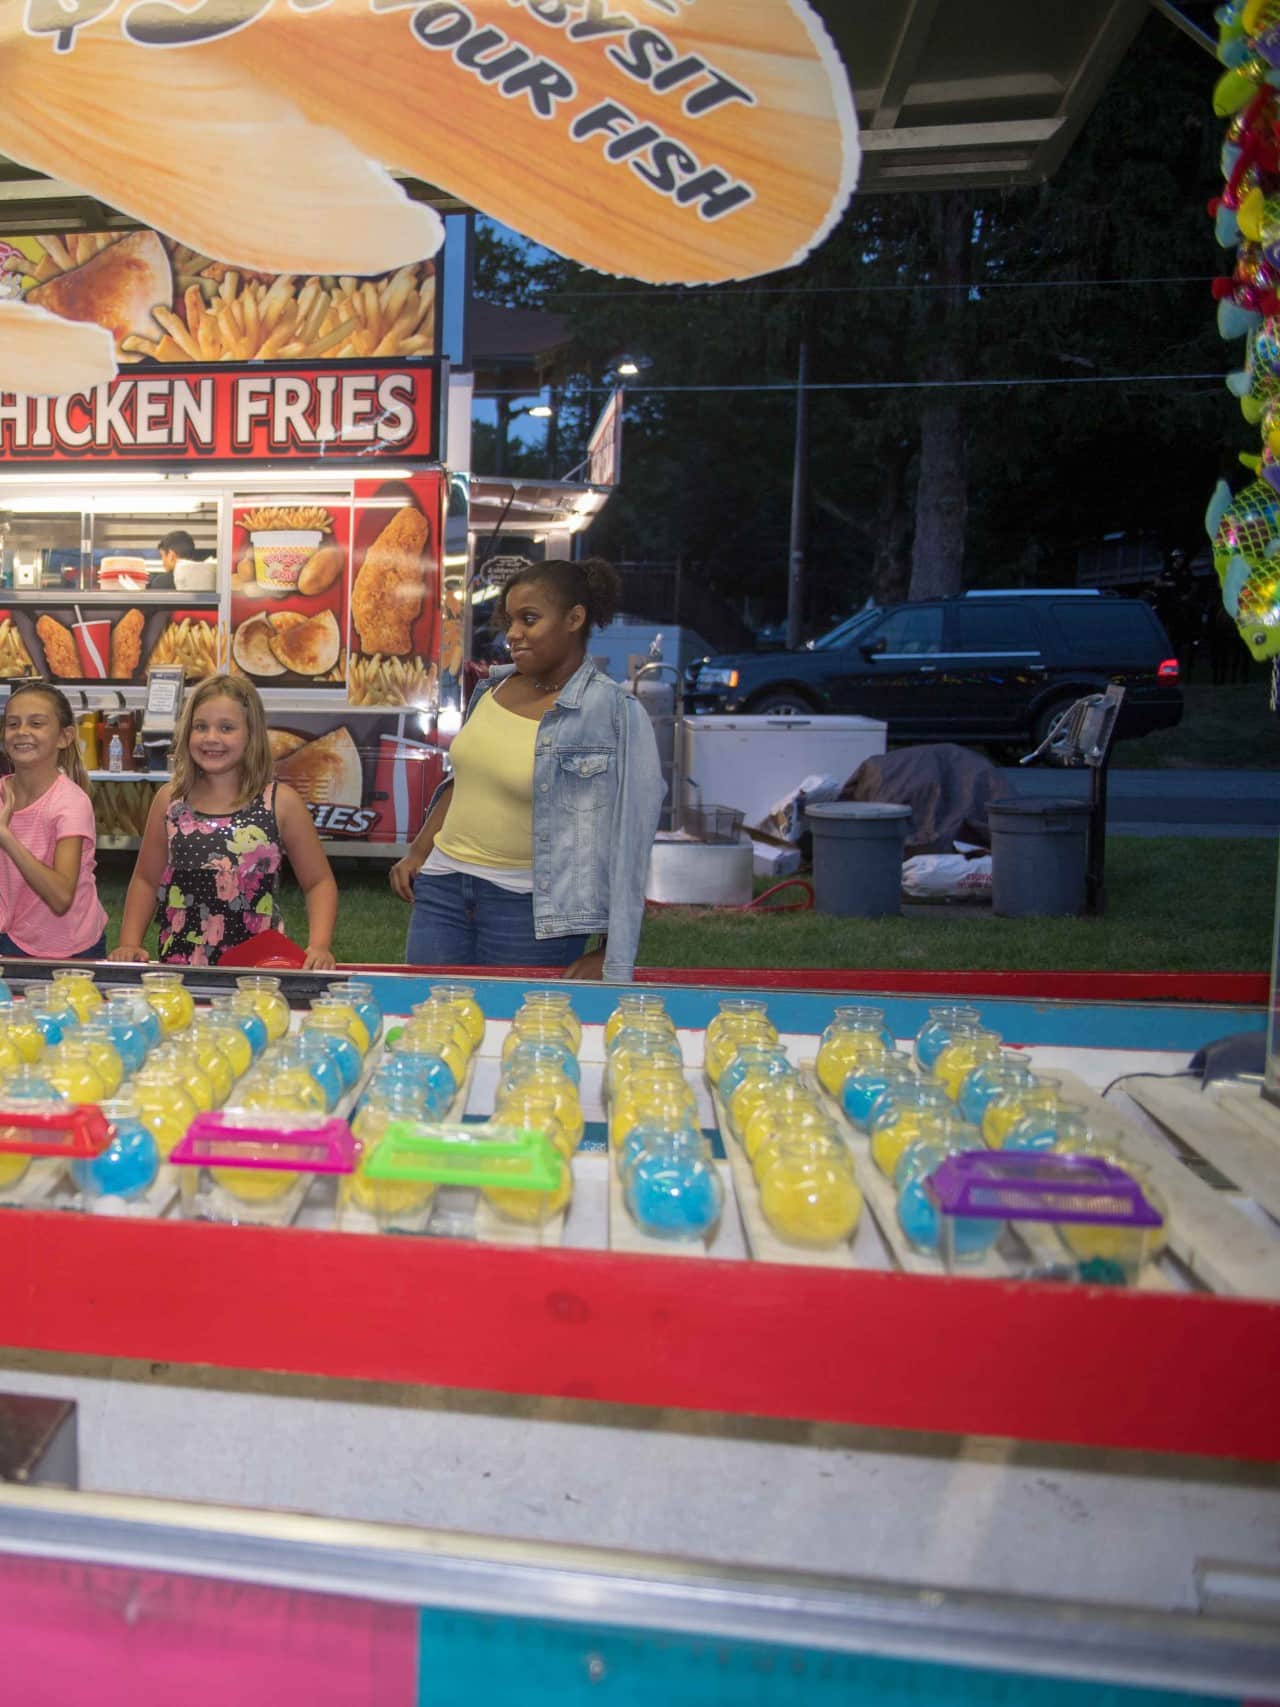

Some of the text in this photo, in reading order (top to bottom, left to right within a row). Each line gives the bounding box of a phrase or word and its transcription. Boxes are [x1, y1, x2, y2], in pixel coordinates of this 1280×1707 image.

[372, 0, 573, 116] OUR
[573, 102, 752, 218] FISH
[236, 375, 414, 443] FRIES
